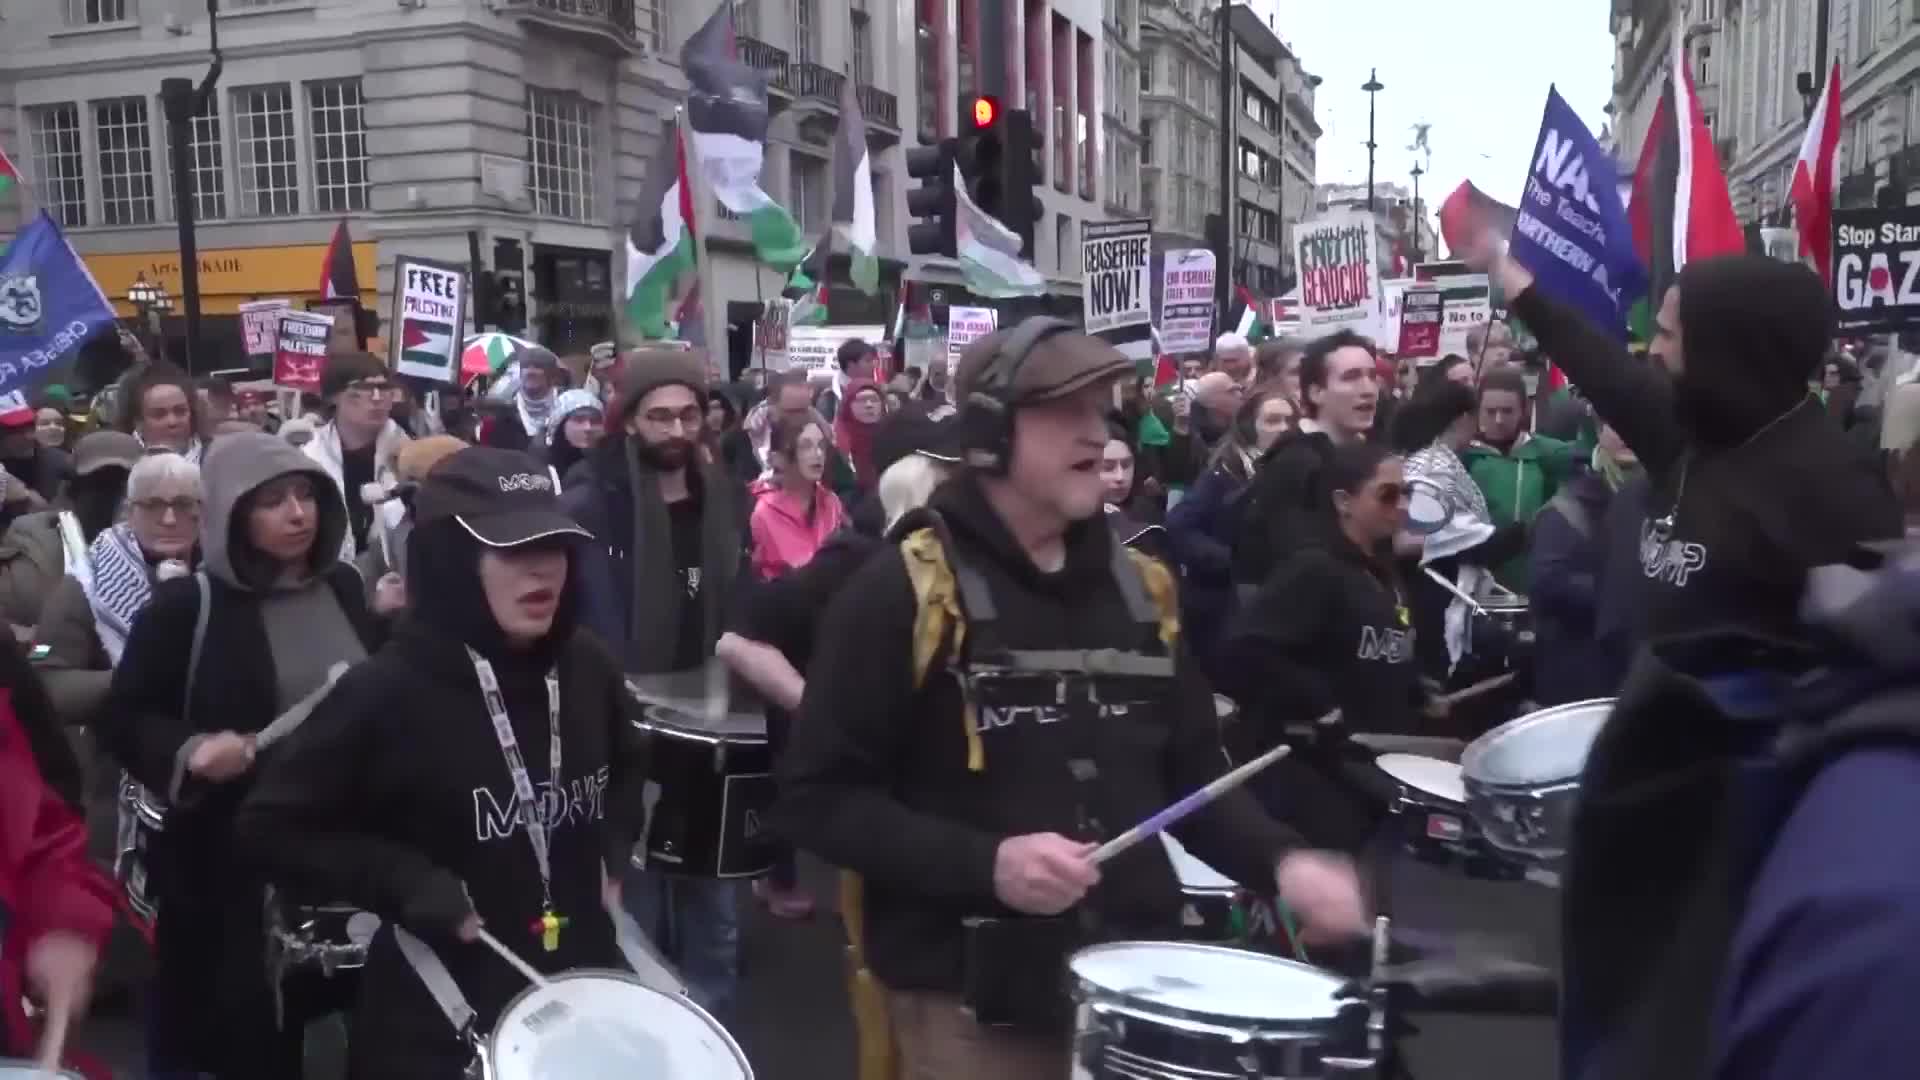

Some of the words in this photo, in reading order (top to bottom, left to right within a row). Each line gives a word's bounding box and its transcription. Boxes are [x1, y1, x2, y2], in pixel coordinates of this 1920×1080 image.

[1838, 224, 1875, 248] Stop
[1084, 237, 1149, 272] CEASEFIRE
[407, 269, 456, 299] FREE
[1091, 269, 1140, 317] NOW!
[1303, 264, 1371, 307] GENOCIDE
[404, 296, 455, 318] PALESTINE
[1449, 311, 1466, 322] No
[1471, 312, 1483, 322] to
